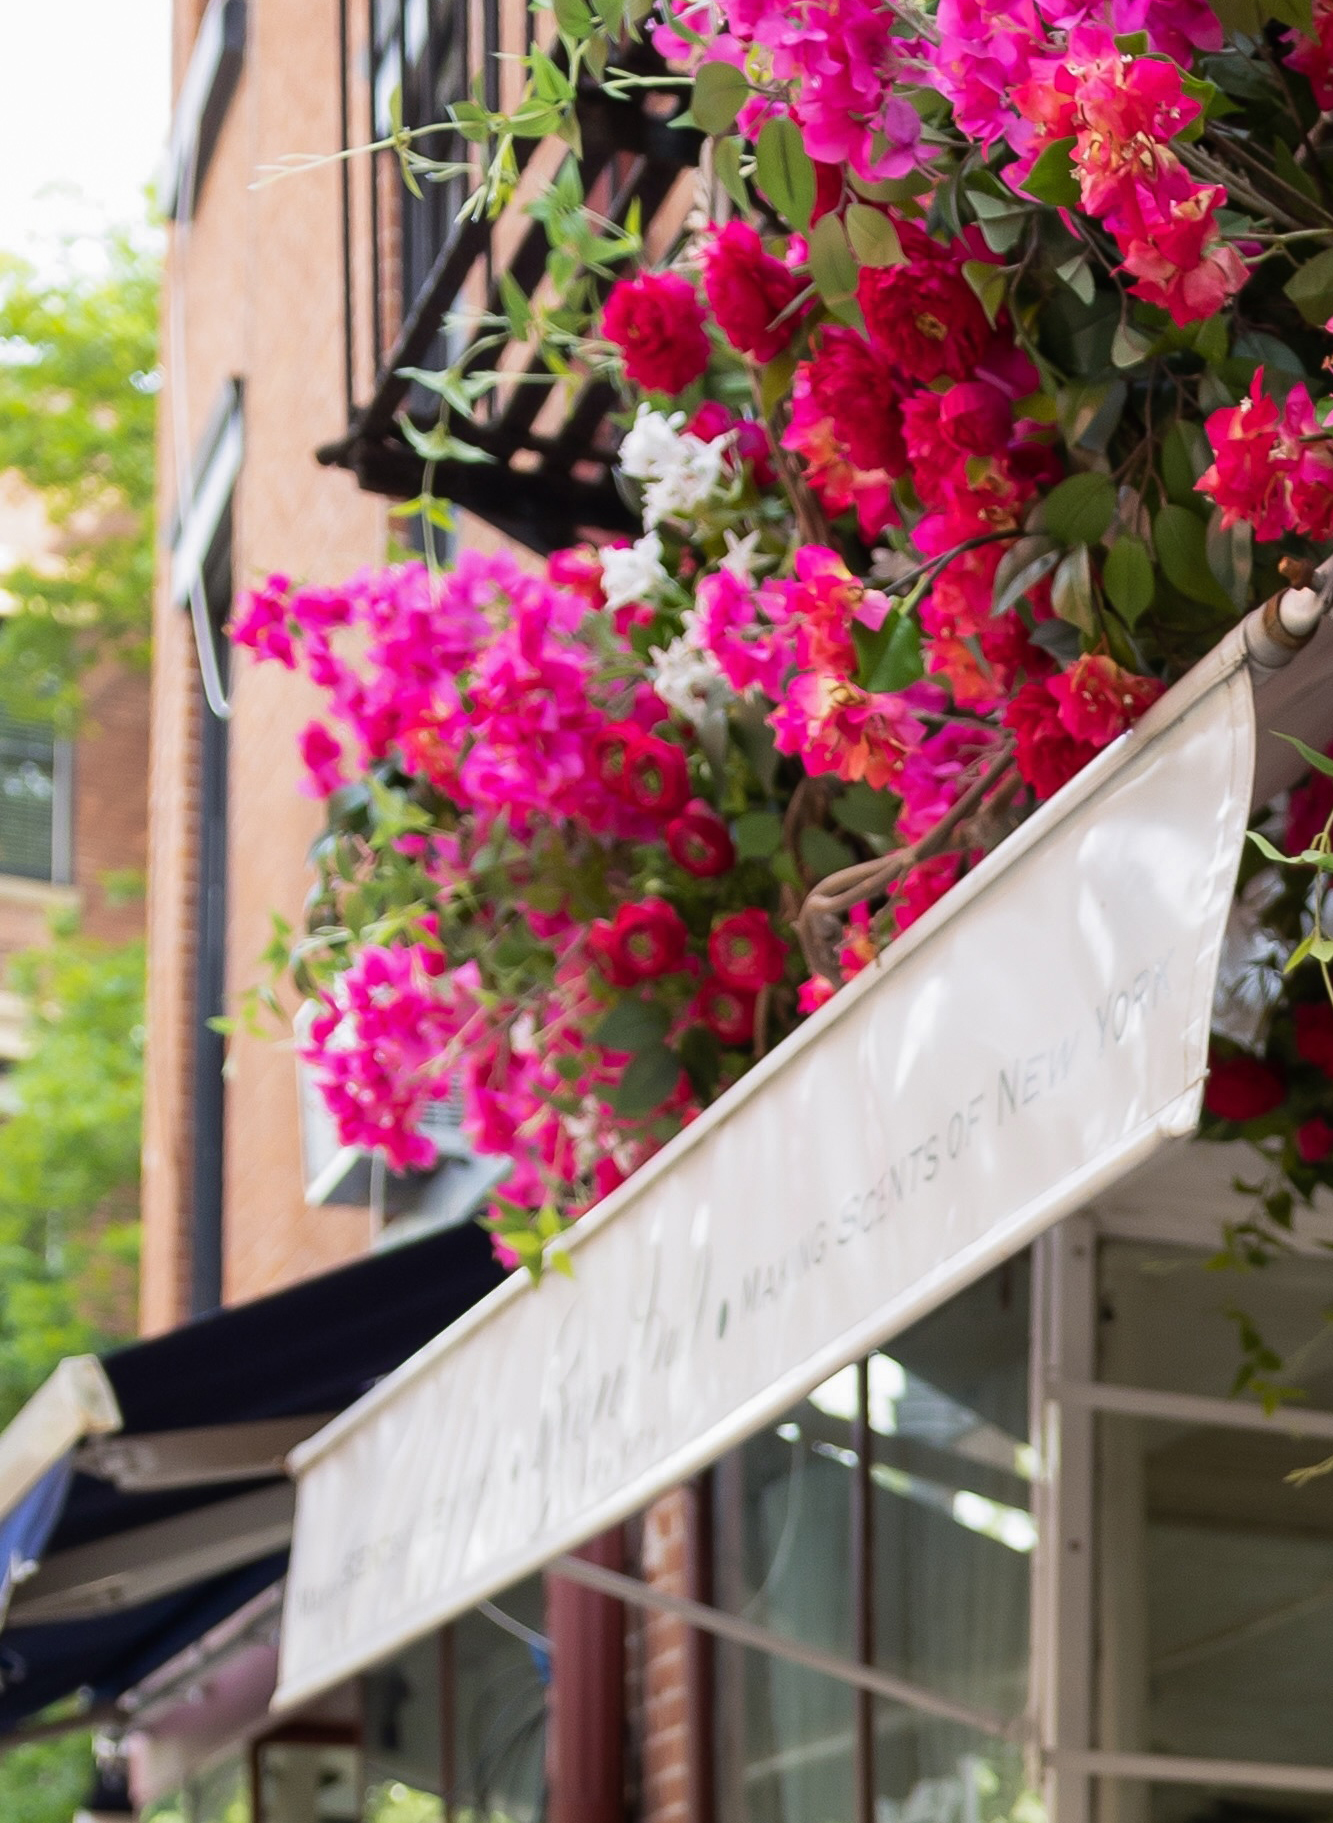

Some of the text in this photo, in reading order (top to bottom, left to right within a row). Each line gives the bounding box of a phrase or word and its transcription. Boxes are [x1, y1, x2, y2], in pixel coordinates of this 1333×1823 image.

[837, 1134, 938, 1246] SCENTS
[947, 1094, 984, 1161] OF
[999, 1030, 1080, 1124] NEW
[1096, 948, 1176, 1056] YORK
